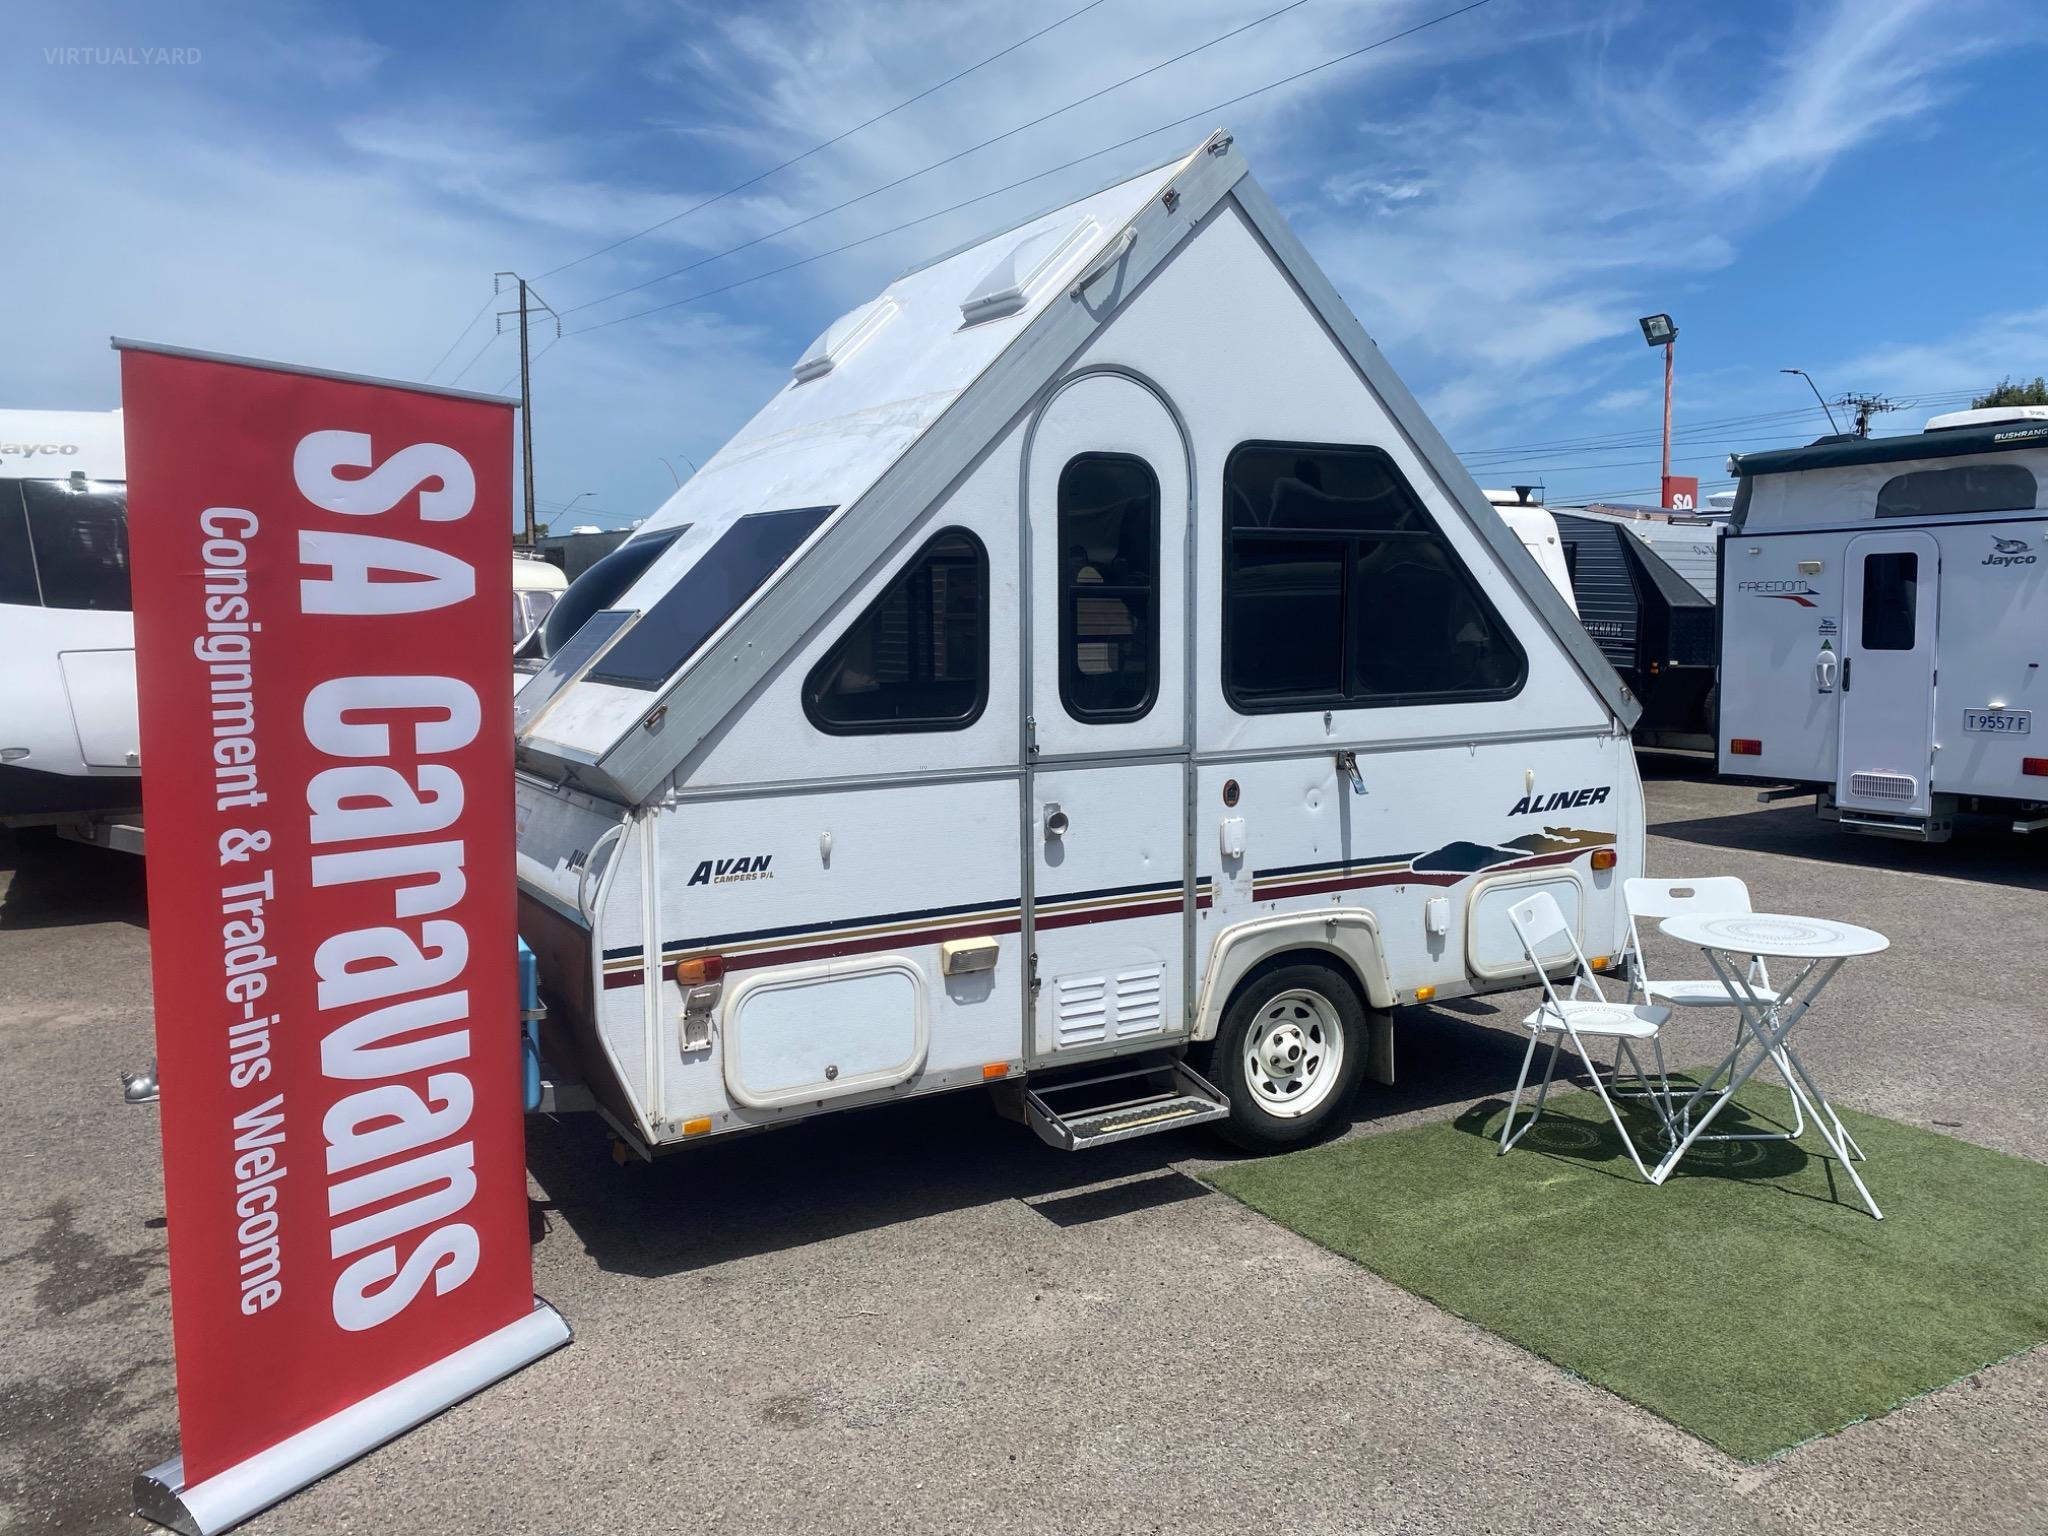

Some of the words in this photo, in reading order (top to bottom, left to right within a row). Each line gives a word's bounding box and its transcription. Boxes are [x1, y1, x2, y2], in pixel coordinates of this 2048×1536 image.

[0, 444, 79, 458] ayco
[1673, 493, 1694, 510] SA
[293, 429, 476, 616] SA
[1981, 553, 2037, 568] Jayco
[1738, 580, 1808, 592] FREEDOM
[193, 506, 268, 812] Consignment
[1507, 786, 1611, 817] ALINER
[218, 829, 272, 866] &
[687, 855, 773, 887] AVAN
[713, 873, 758, 884] CAMPERS
[221, 869, 280, 1089] Trade-ins
[303, 675, 482, 1332] Caravans
[232, 1093, 288, 1317] Welcome
